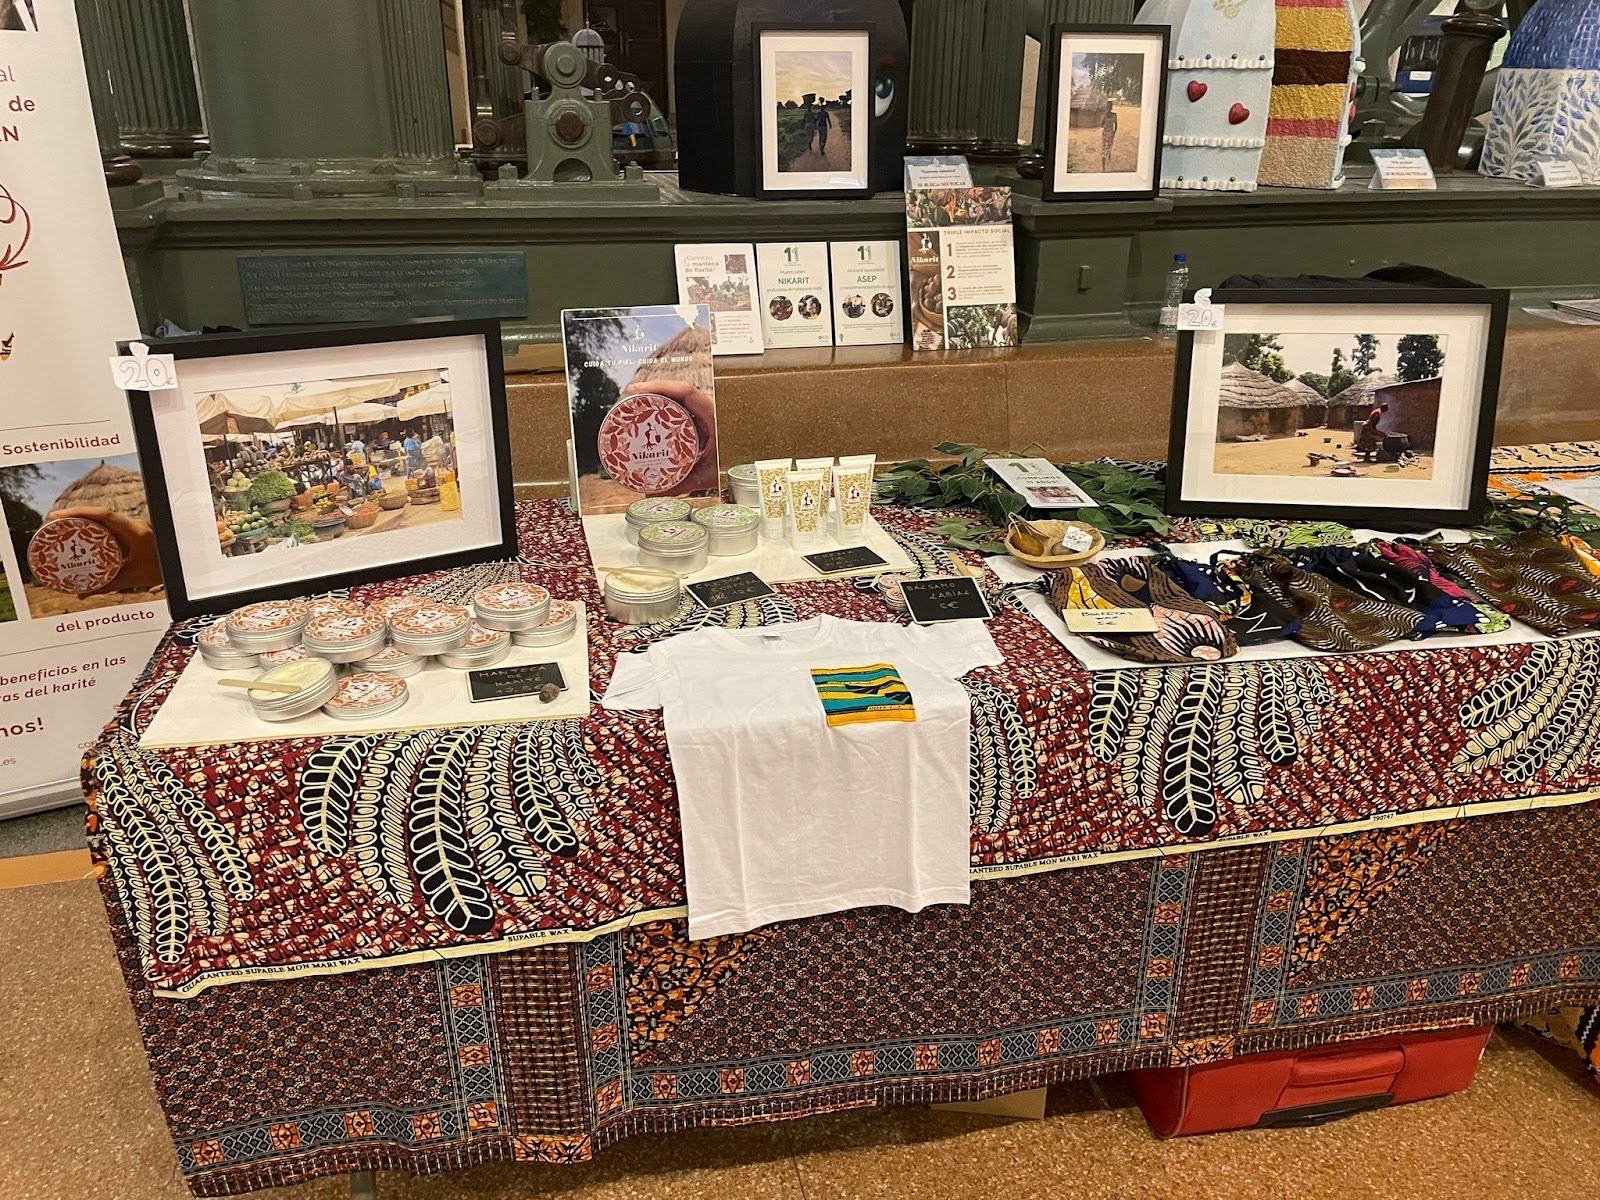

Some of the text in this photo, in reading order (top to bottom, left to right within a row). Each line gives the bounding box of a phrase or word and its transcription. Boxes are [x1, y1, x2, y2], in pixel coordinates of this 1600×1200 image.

[8, 95, 35, 112] de
[946, 243, 952, 257] 1
[857, 275, 877, 283] ASEP
[946, 265, 956, 279] 2
[778, 277, 810, 285] NIKARIT
[947, 286, 957, 301] 3
[622, 344, 658, 353] Nikarit
[583, 360, 605, 368] CUIDA
[2, 433, 121, 455] Sostenibilidad
[631, 449, 669, 460] Nikarit
[56, 610, 155, 633] del producto
[0, 656, 127, 686] beneficios en las
[24, 685, 49, 699] del
[53, 676, 97, 694] karité
[1373, 813, 1394, 822] 790747
[1005, 861, 1037, 871] SUPABLE
[1081, 852, 1099, 860] WAX
[507, 928, 570, 942] SUPABLE WAX
[182, 957, 362, 993] GUARANTEED SUPABLE MON MARI WAX
